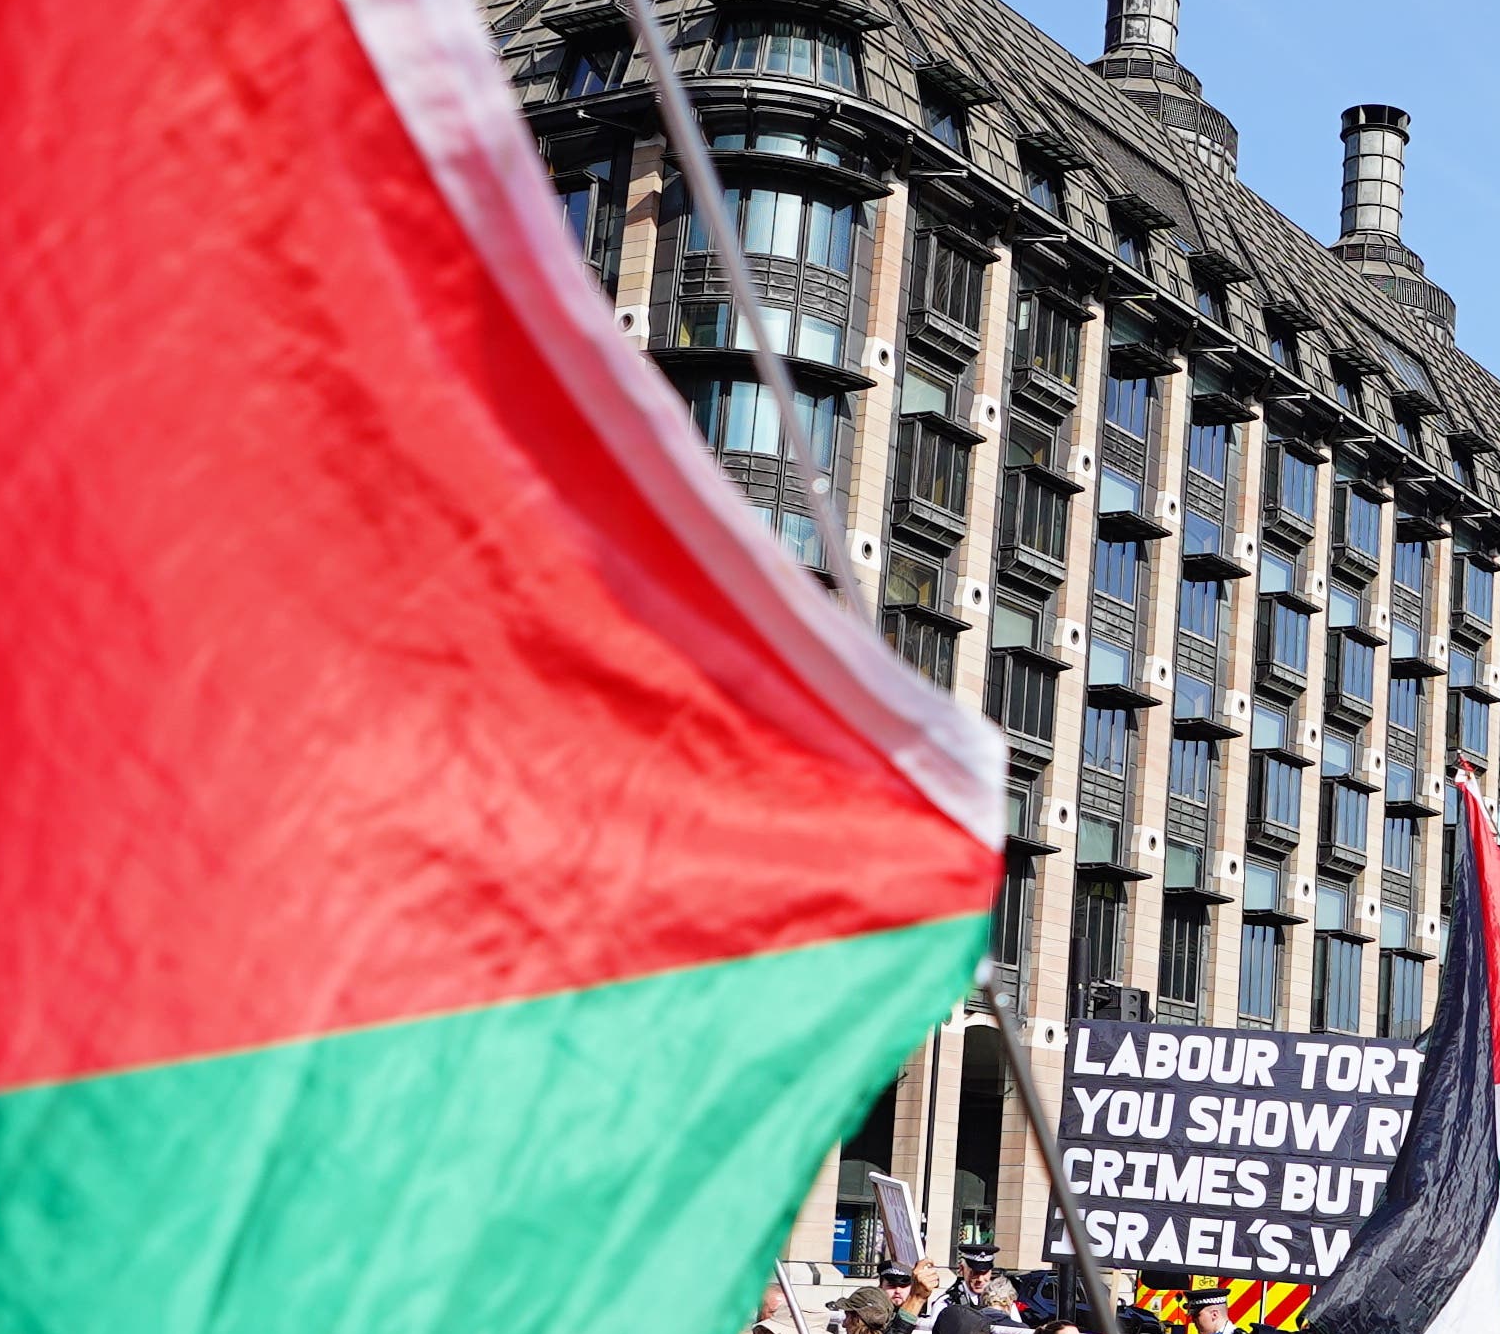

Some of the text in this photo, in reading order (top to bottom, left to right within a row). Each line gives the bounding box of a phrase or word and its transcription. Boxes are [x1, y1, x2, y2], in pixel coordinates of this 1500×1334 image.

[1073, 1026, 1426, 1097] LABOUR TORI
[1071, 1086, 1176, 1141] YOU
[1185, 1095, 1353, 1153] SHOW
[1061, 1146, 1388, 1218] CRIMES BUT
